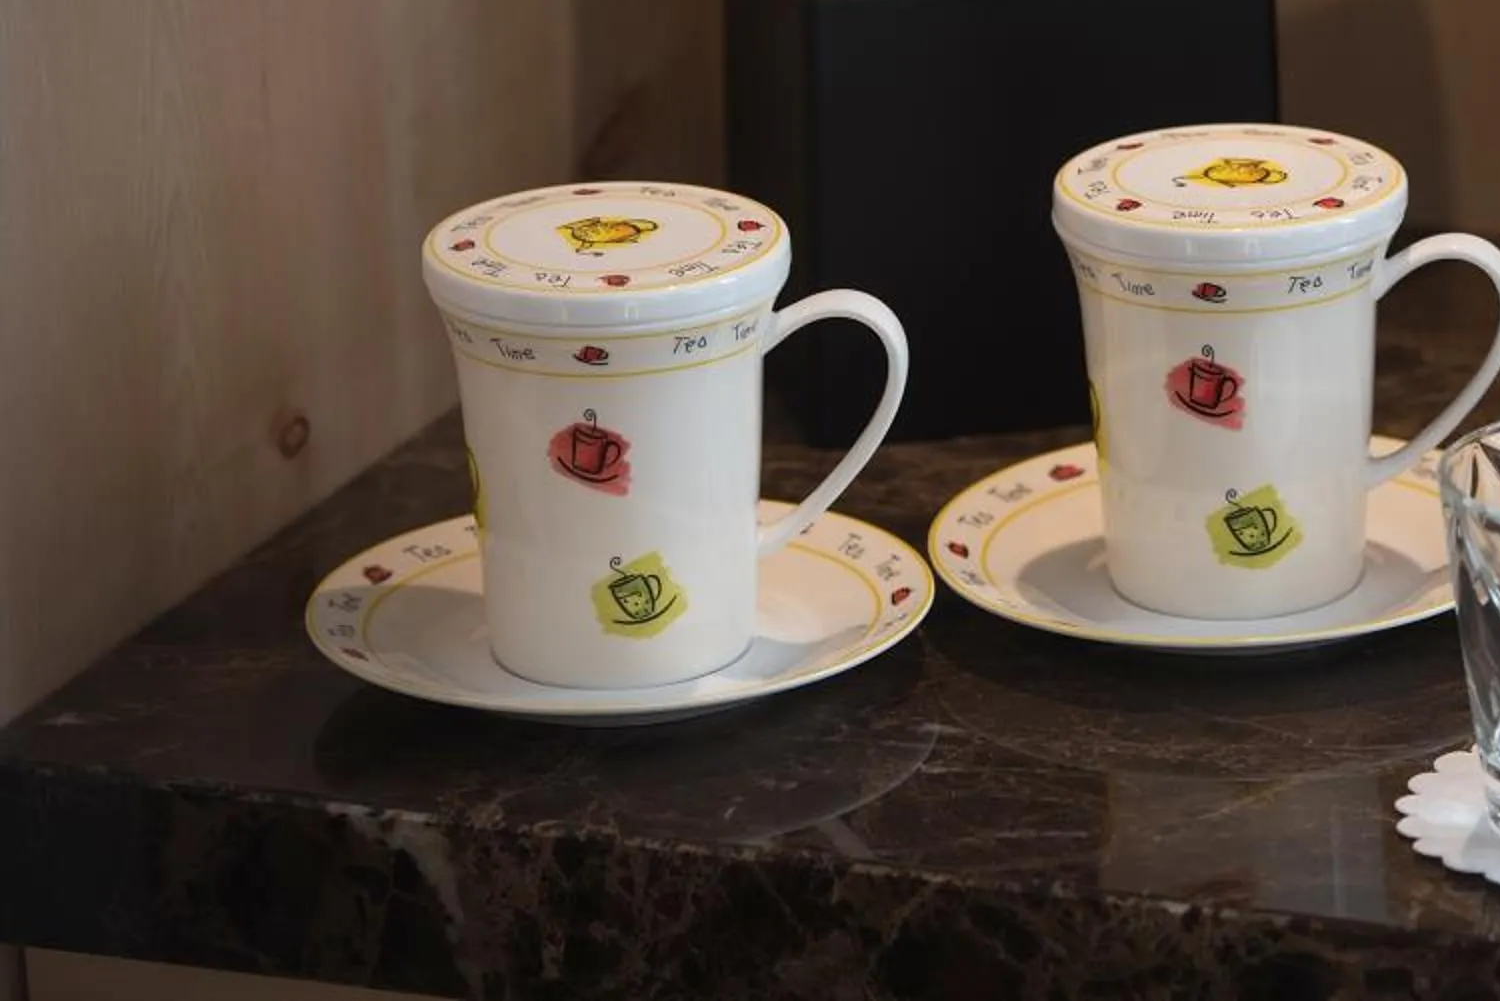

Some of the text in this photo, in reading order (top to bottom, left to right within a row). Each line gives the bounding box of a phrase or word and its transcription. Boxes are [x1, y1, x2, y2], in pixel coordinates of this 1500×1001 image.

[668, 260, 720, 278] Time
[535, 272, 572, 289] Tea
[1111, 272, 1156, 296] Time
[1287, 275, 1324, 295] Tea
[488, 337, 537, 361] Time
[672, 335, 708, 355] Tea
[401, 544, 452, 563] Tea
